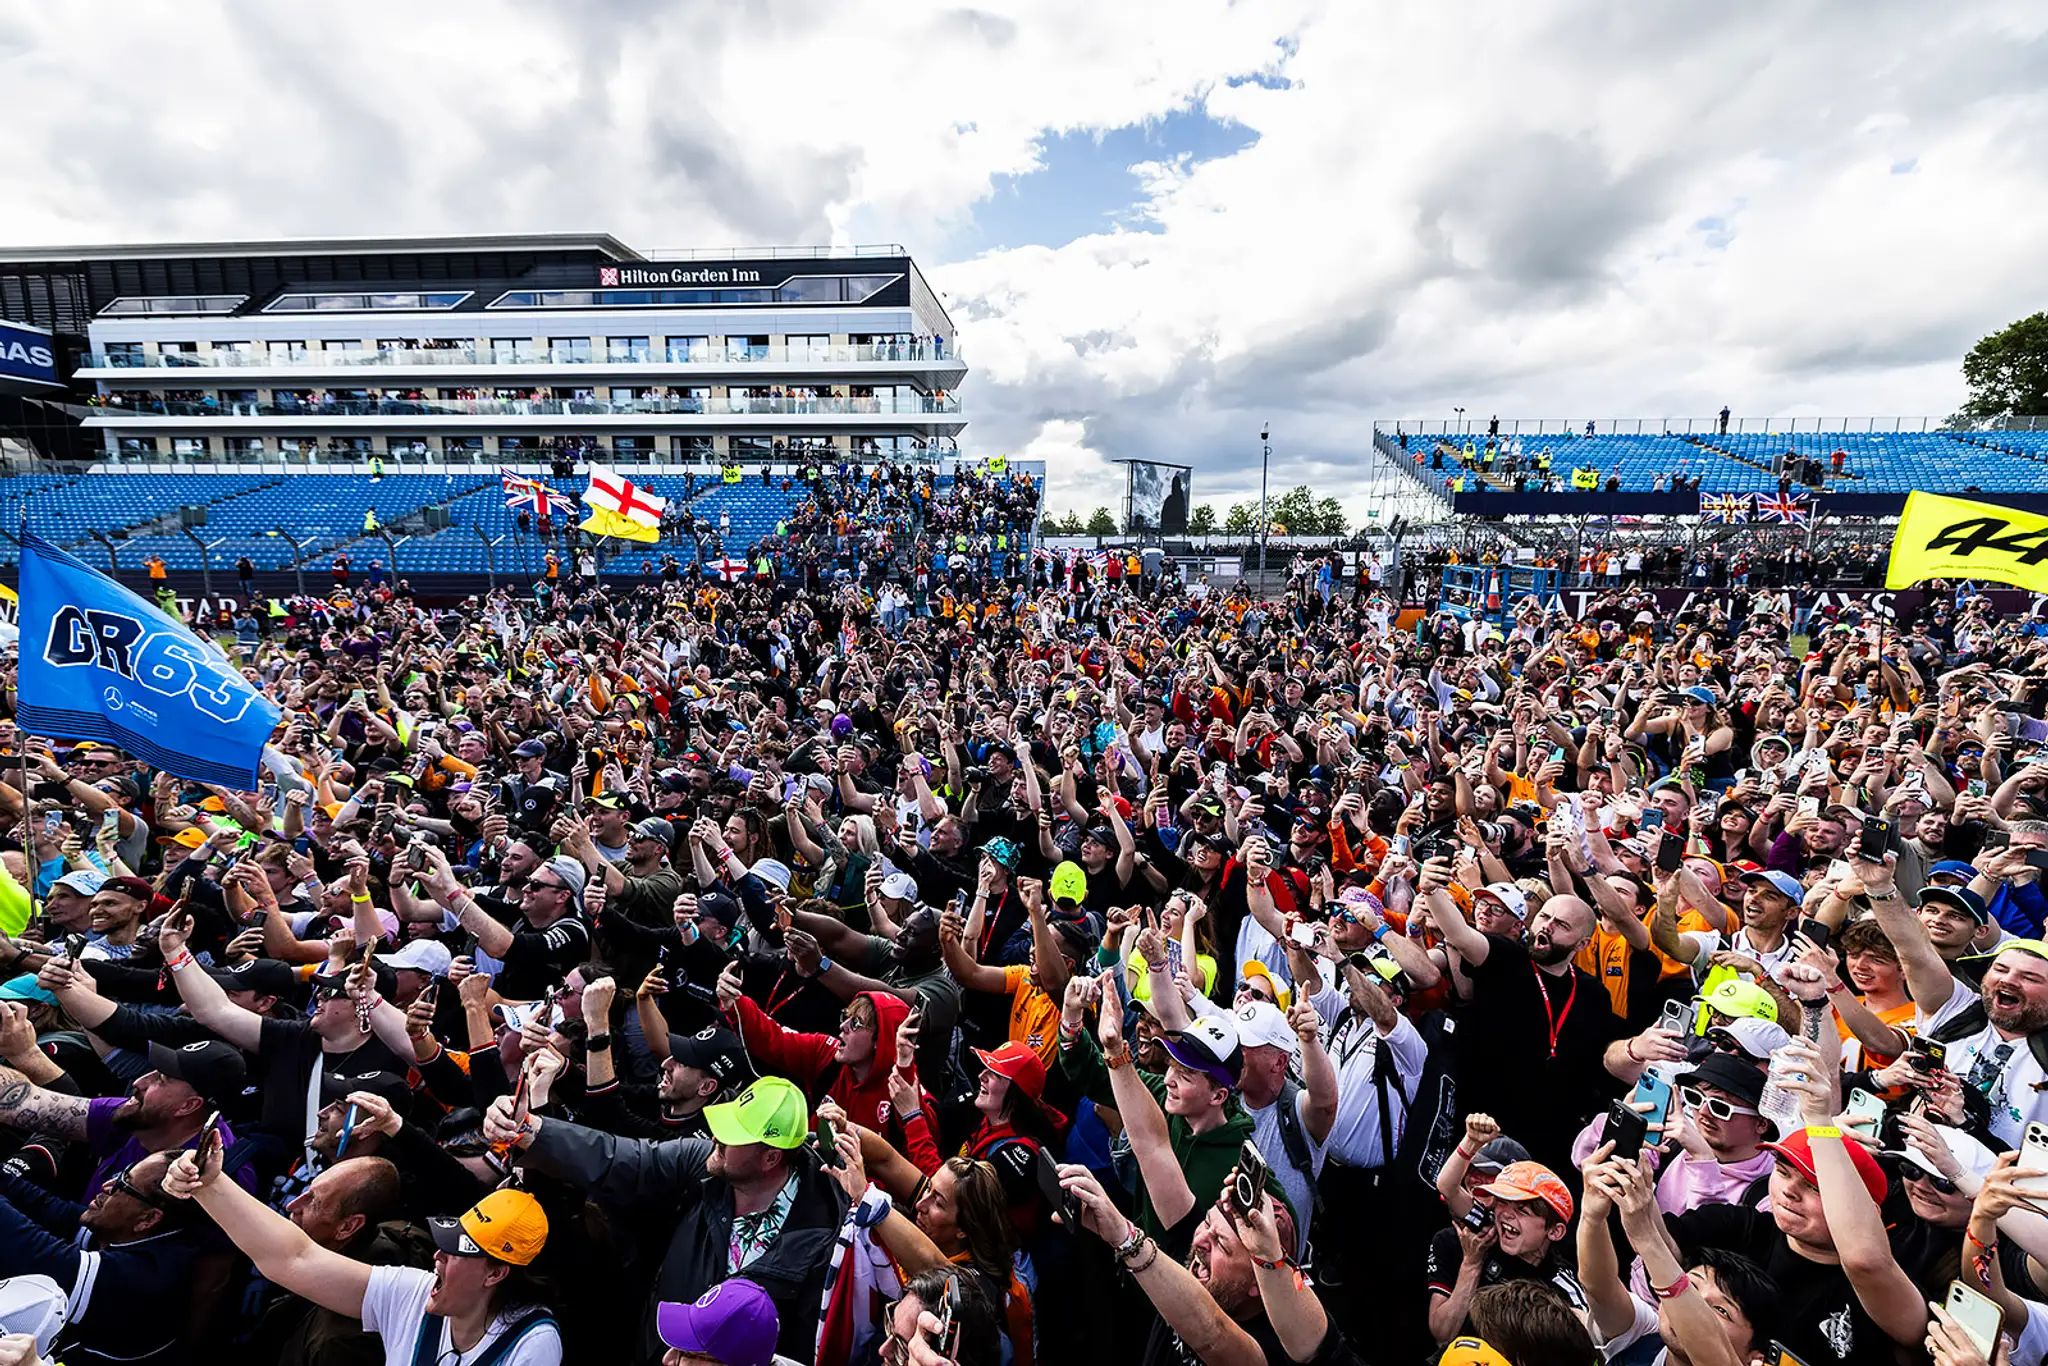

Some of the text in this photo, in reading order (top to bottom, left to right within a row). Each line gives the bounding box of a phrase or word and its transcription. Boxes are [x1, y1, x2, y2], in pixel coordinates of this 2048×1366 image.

[620, 268, 760, 284] Hilton Garden Inn
[0, 341, 54, 368] AS
[1925, 517, 2048, 566] 44
[1208, 1027, 1225, 1041] 44
